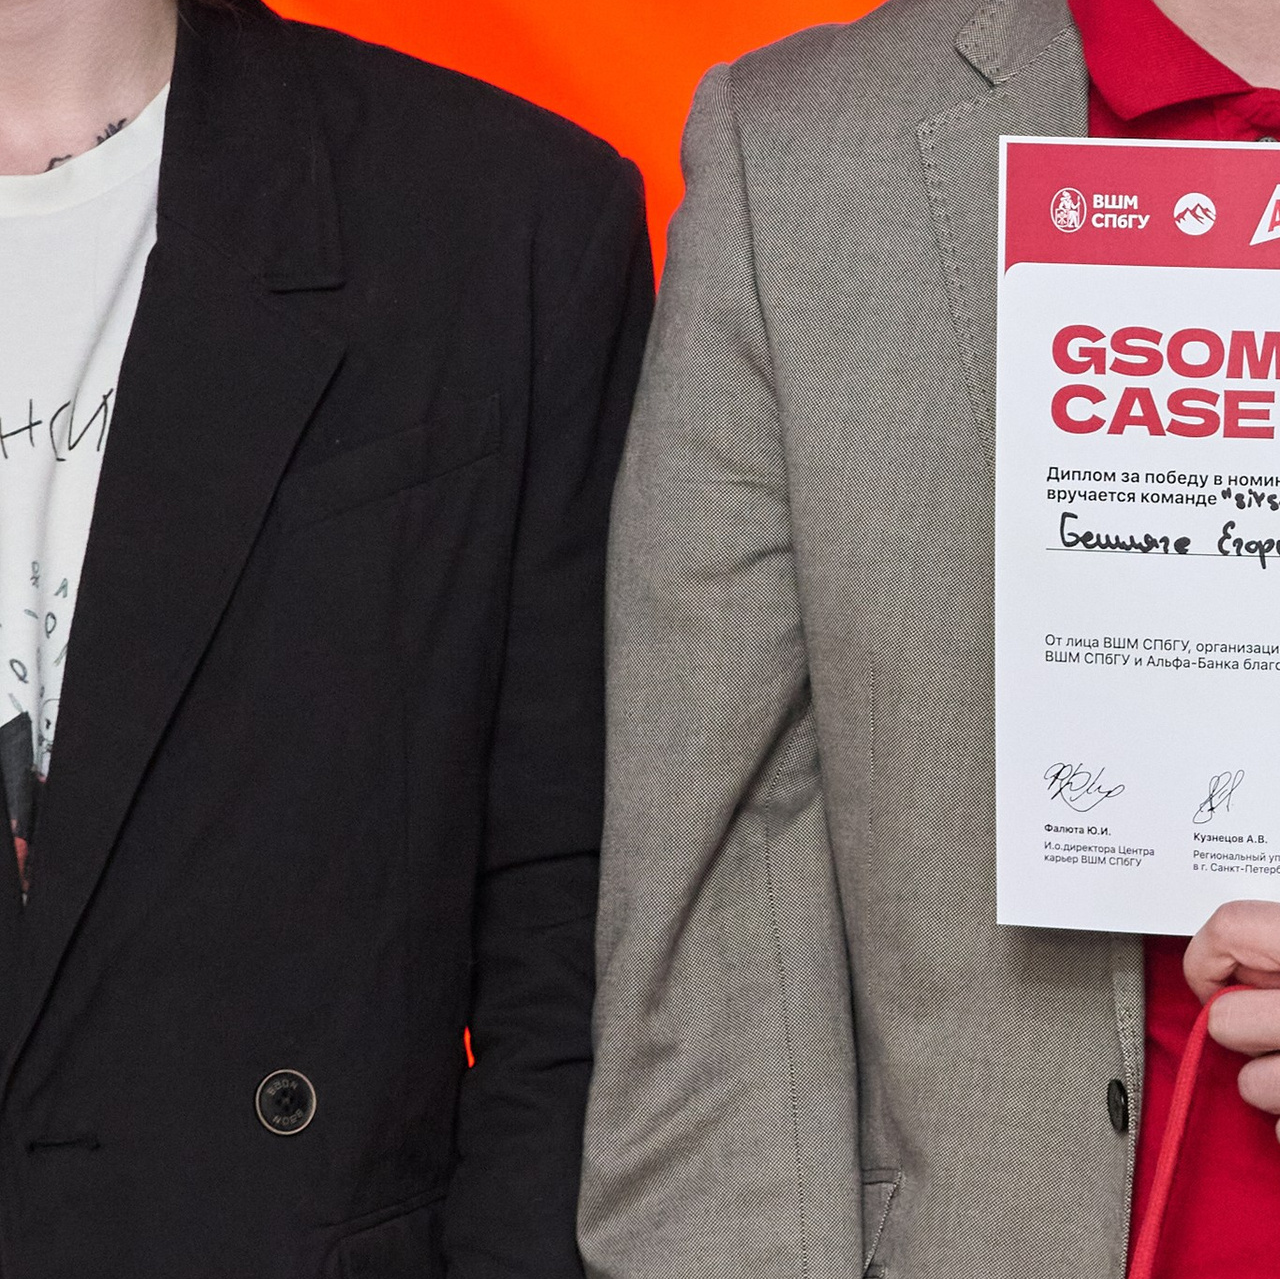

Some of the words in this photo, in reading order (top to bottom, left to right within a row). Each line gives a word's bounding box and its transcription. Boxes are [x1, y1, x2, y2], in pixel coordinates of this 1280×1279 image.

[1092, 194, 1139, 211] ВШМ
[1091, 213, 1150, 230] СПбГУ
[1051, 384, 1276, 440] CASE
[1047, 466, 1116, 484] Диплом
[1121, 472, 1140, 483] за
[1145, 470, 1209, 488] победу
[1213, 474, 1223, 486] в
[1046, 488, 1136, 505] вручается
[1140, 490, 1217, 507] команде
[1045, 633, 1062, 647] От
[1066, 638, 1099, 650] лица
[1103, 637, 1138, 650] ВШМ
[1142, 638, 1192, 654] СПбГУ,
[1045, 650, 1080, 663] ВШМ
[1084, 652, 1130, 666] СПбГУ
[1134, 656, 1142, 666] и
[1146, 654, 1239, 671] Альфа-Банка
[1044, 823, 1085, 835] Фалюта
[1087, 825, 1112, 836] Ю.И.
[1193, 832, 1244, 845] Кузнецов
[1246, 834, 1268, 844] А.В.
[1044, 841, 1116, 854] И.о.директора
[1118, 845, 1155, 857] Центра
[1193, 849, 1266, 862] Региональный
[1044, 854, 1079, 865] карьер
[1081, 855, 1107, 865] ВШМ
[1109, 856, 1142, 867] СПбГУ
[1193, 863, 1199, 871] в
[1201, 863, 1208, 871] г.
